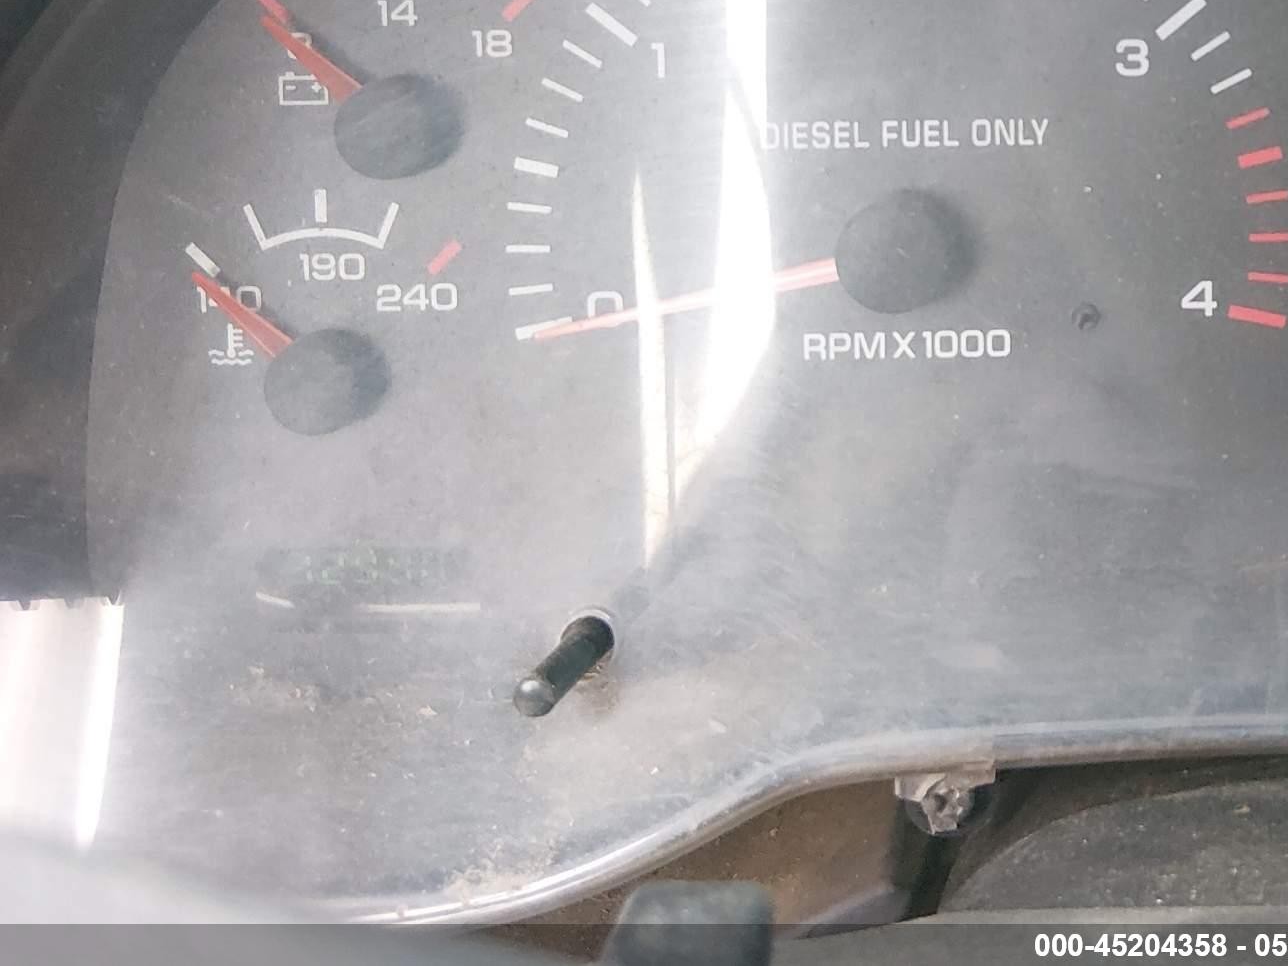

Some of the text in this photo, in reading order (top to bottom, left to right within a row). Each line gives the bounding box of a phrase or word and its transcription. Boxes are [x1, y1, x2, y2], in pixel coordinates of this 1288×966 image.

[378, 0, 417, 26] 14
[472, 30, 512, 57] 18
[1115, 40, 1149, 76] 3
[650, 44, 667, 77] 1
[762, 119, 1048, 149] DIESEL FUEL ONLY
[301, 253, 365, 281] 190
[376, 284, 457, 311] 240
[587, 291, 623, 326] 0
[1181, 281, 1217, 317] 4
